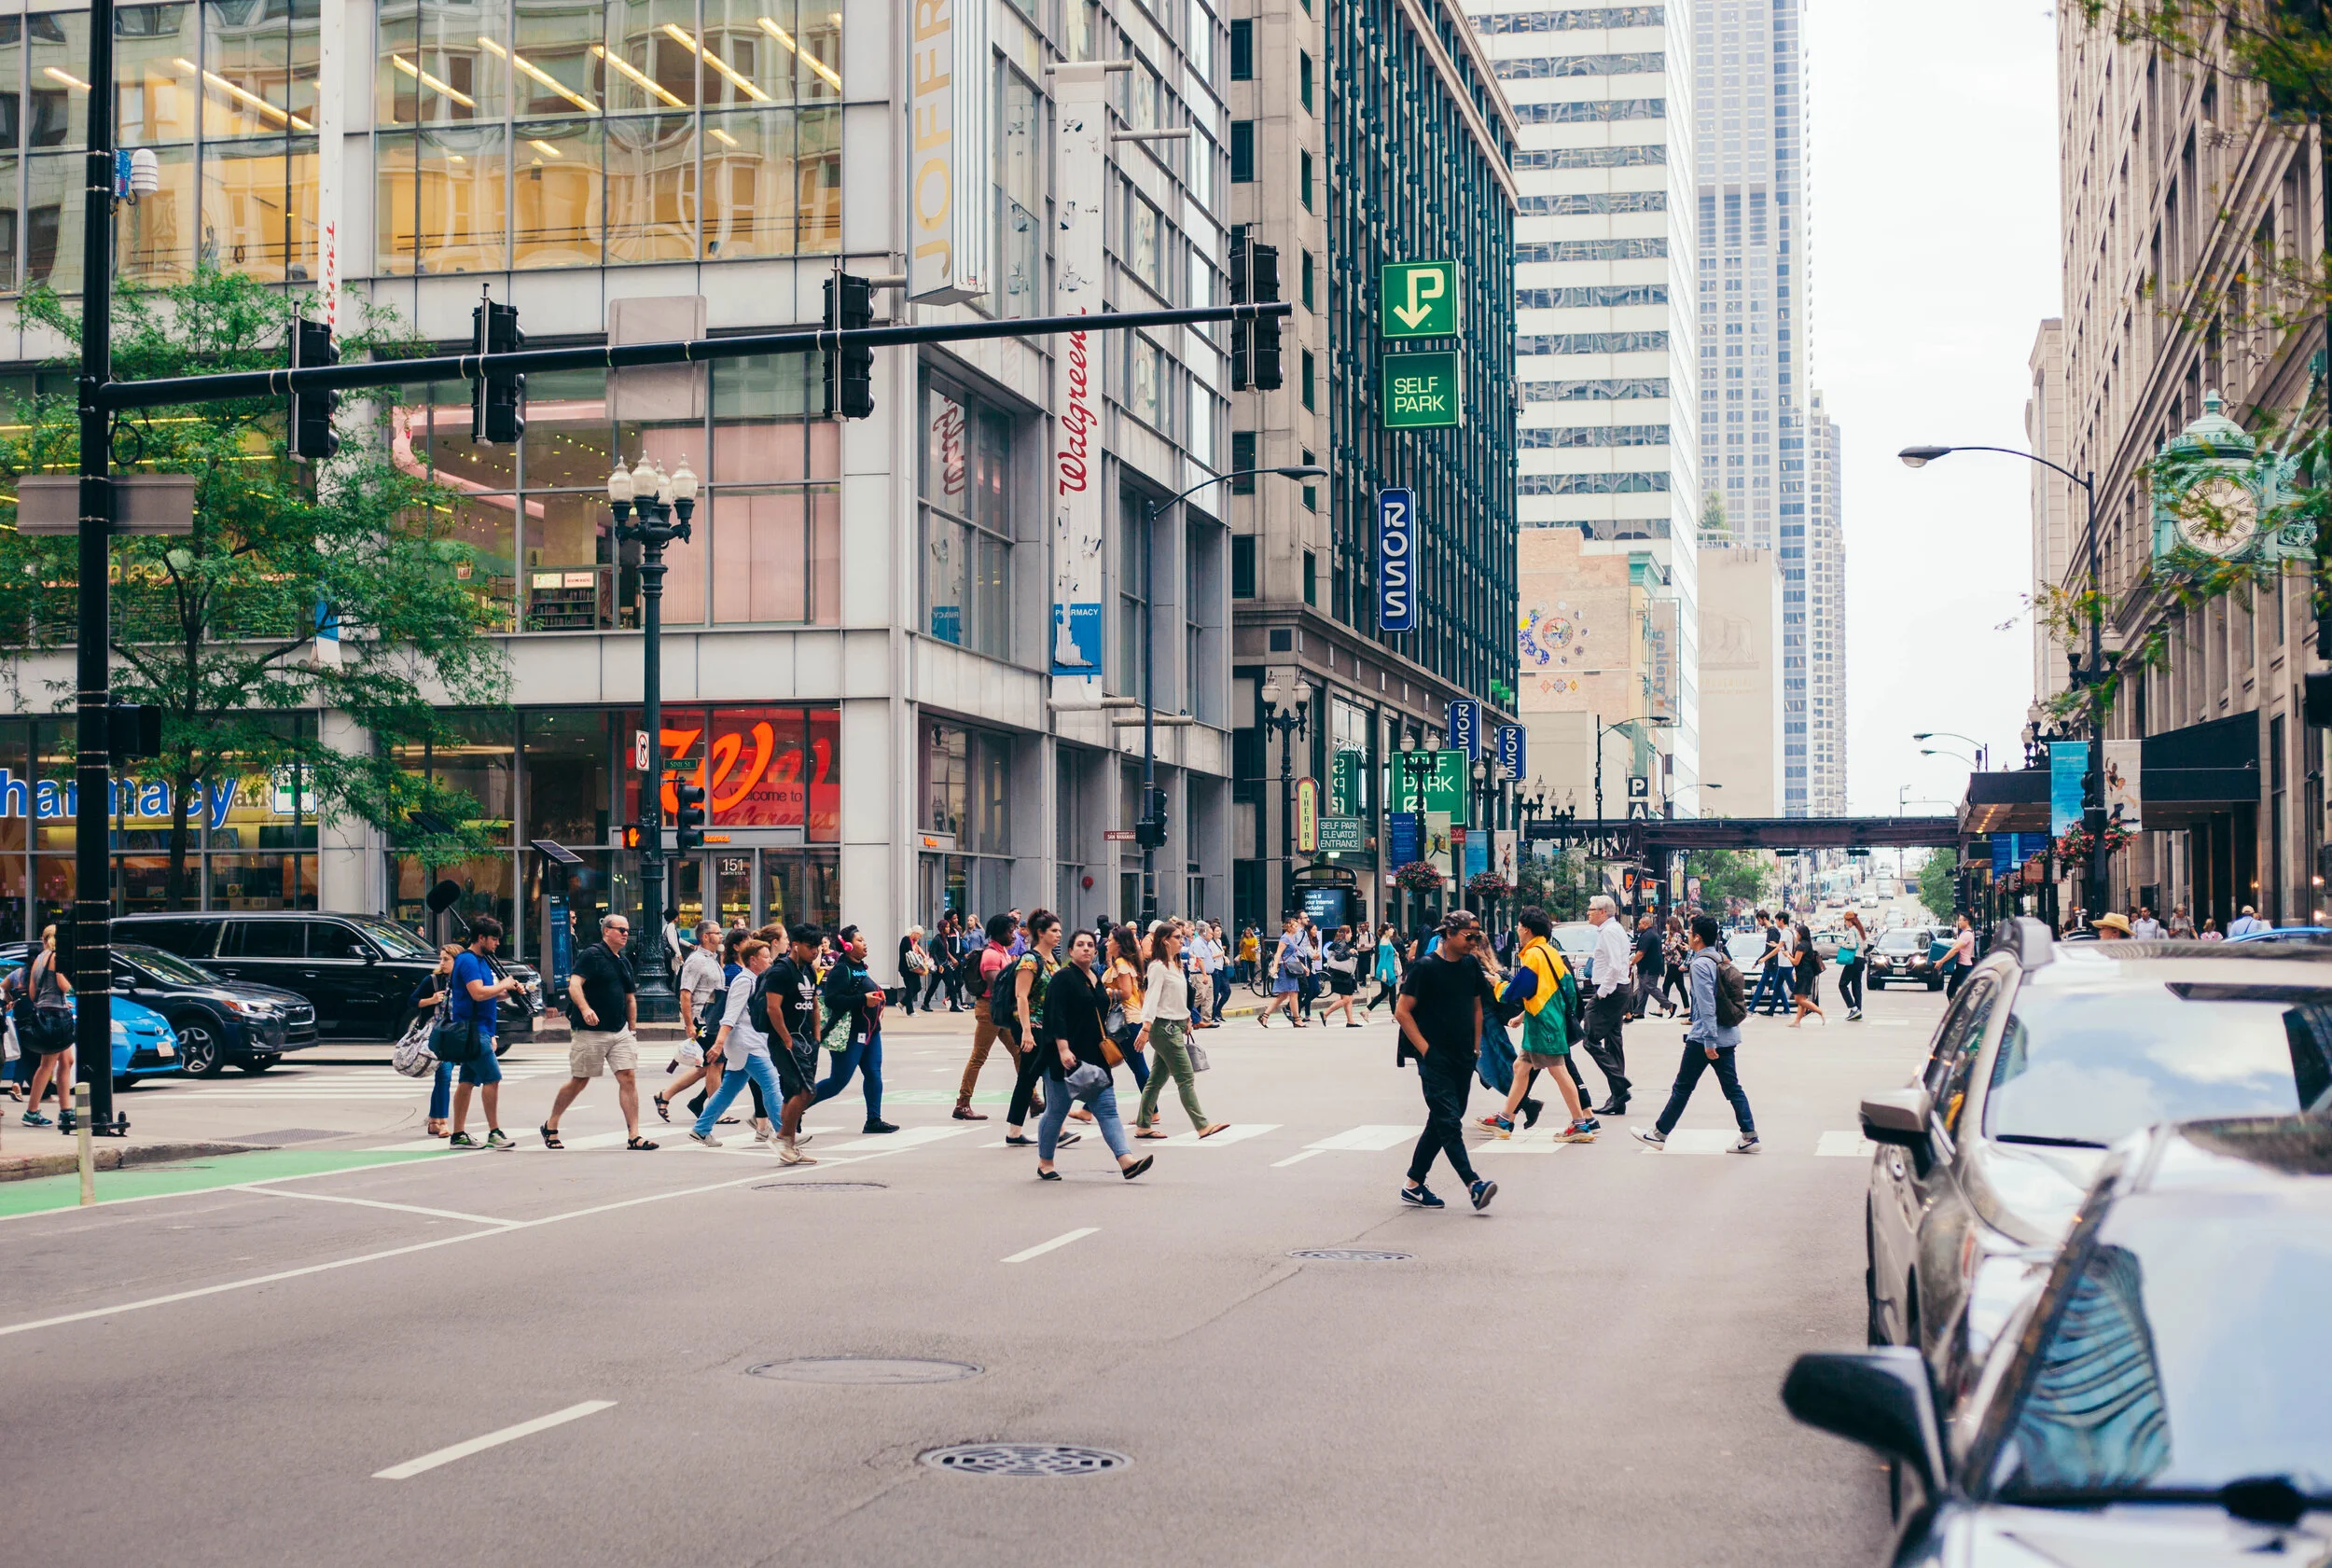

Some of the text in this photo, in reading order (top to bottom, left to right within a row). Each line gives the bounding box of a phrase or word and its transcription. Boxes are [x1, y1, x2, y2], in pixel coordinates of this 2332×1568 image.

[1395, 376, 1438, 395] SELF
[1395, 395, 1445, 413] PARK
[1382, 502, 1408, 617] ROSS
[1055, 608, 1099, 617] PHRMACY
[1653, 631, 1669, 695] gallery
[1506, 728, 1518, 778] ROSS
[1403, 776, 1454, 792] PARK
[790, 790, 802, 802] to
[1320, 822, 1339, 830] SELF
[1322, 830, 1357, 839] ELEVATOR
[722, 858, 743, 871] 151
